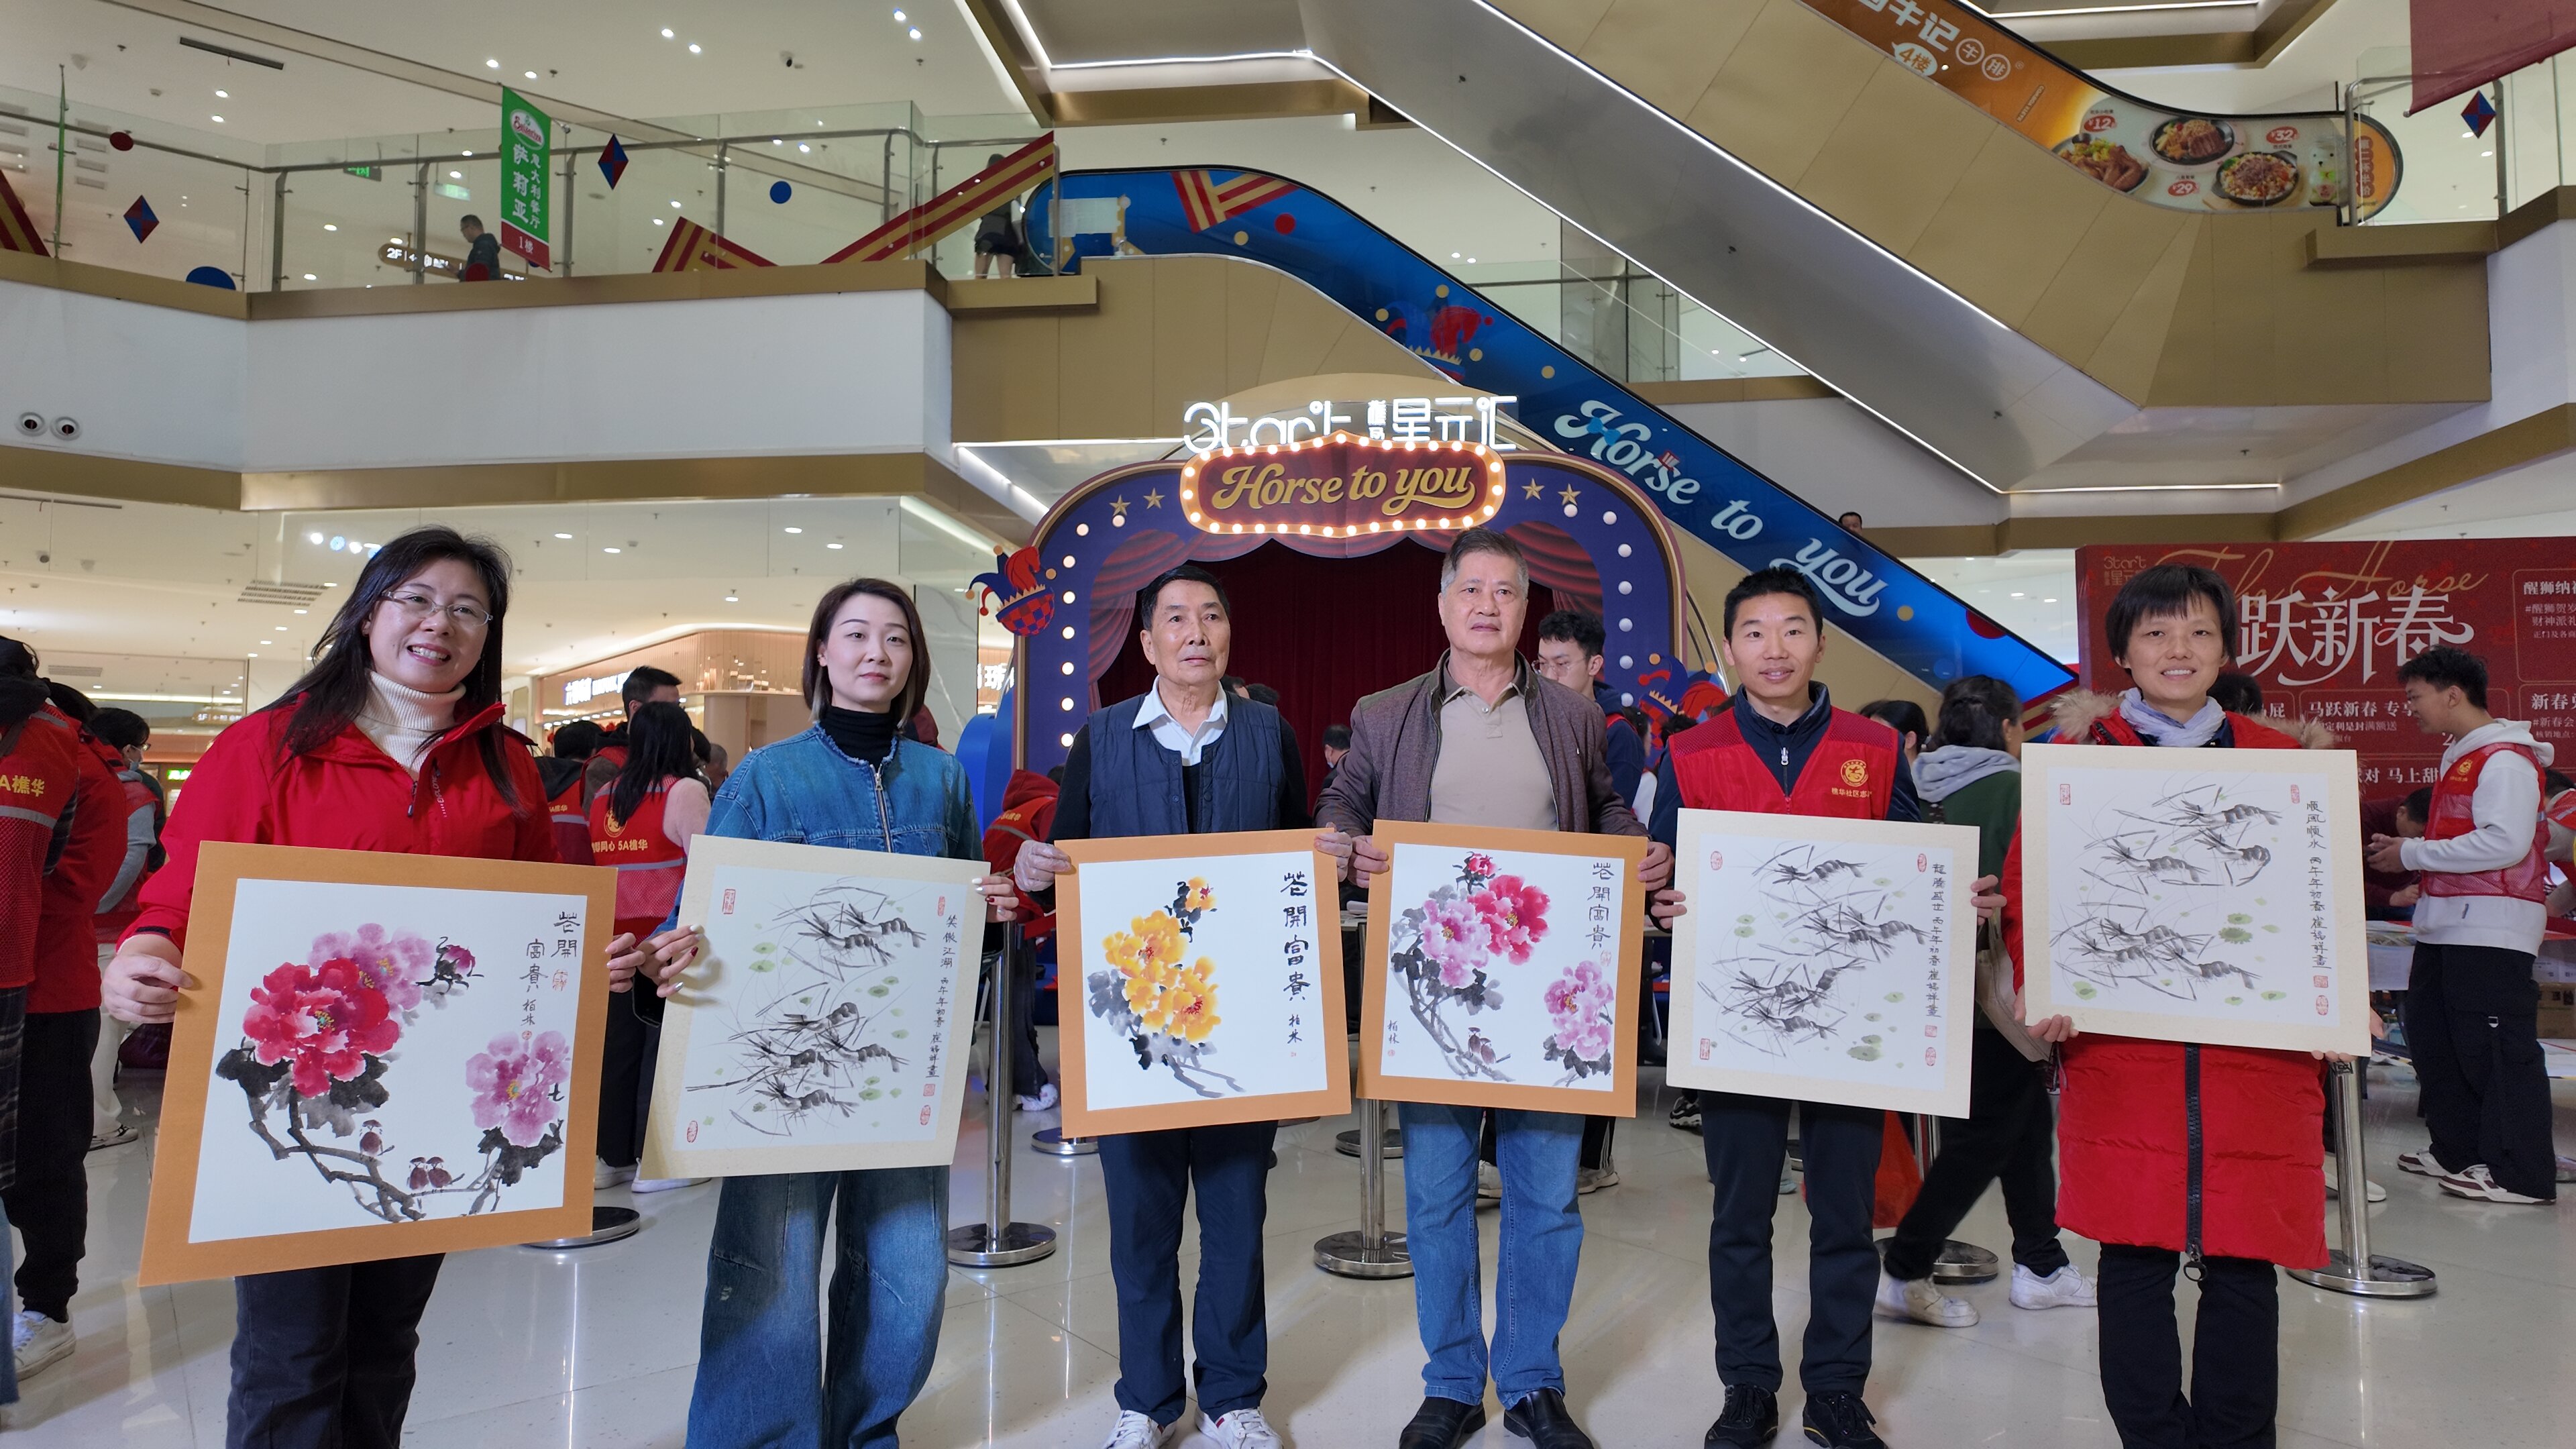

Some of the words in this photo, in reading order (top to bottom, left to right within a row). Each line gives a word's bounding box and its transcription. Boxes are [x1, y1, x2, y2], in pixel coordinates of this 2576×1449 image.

[1852, 0, 1961, 52] 牛记
[1962, 42, 2006, 76] 牛排
[1898, 48, 1933, 74] 4楼
[513, 144, 529, 223] 萨莉亚
[1212, 462, 1344, 510] Horse
[1348, 462, 1387, 500] to
[1381, 466, 1477, 516] you
[1554, 400, 1701, 505] Horse
[1711, 498, 1764, 540] to
[1770, 537, 1888, 617] you
[2309, 701, 2377, 718] 马跃新春
